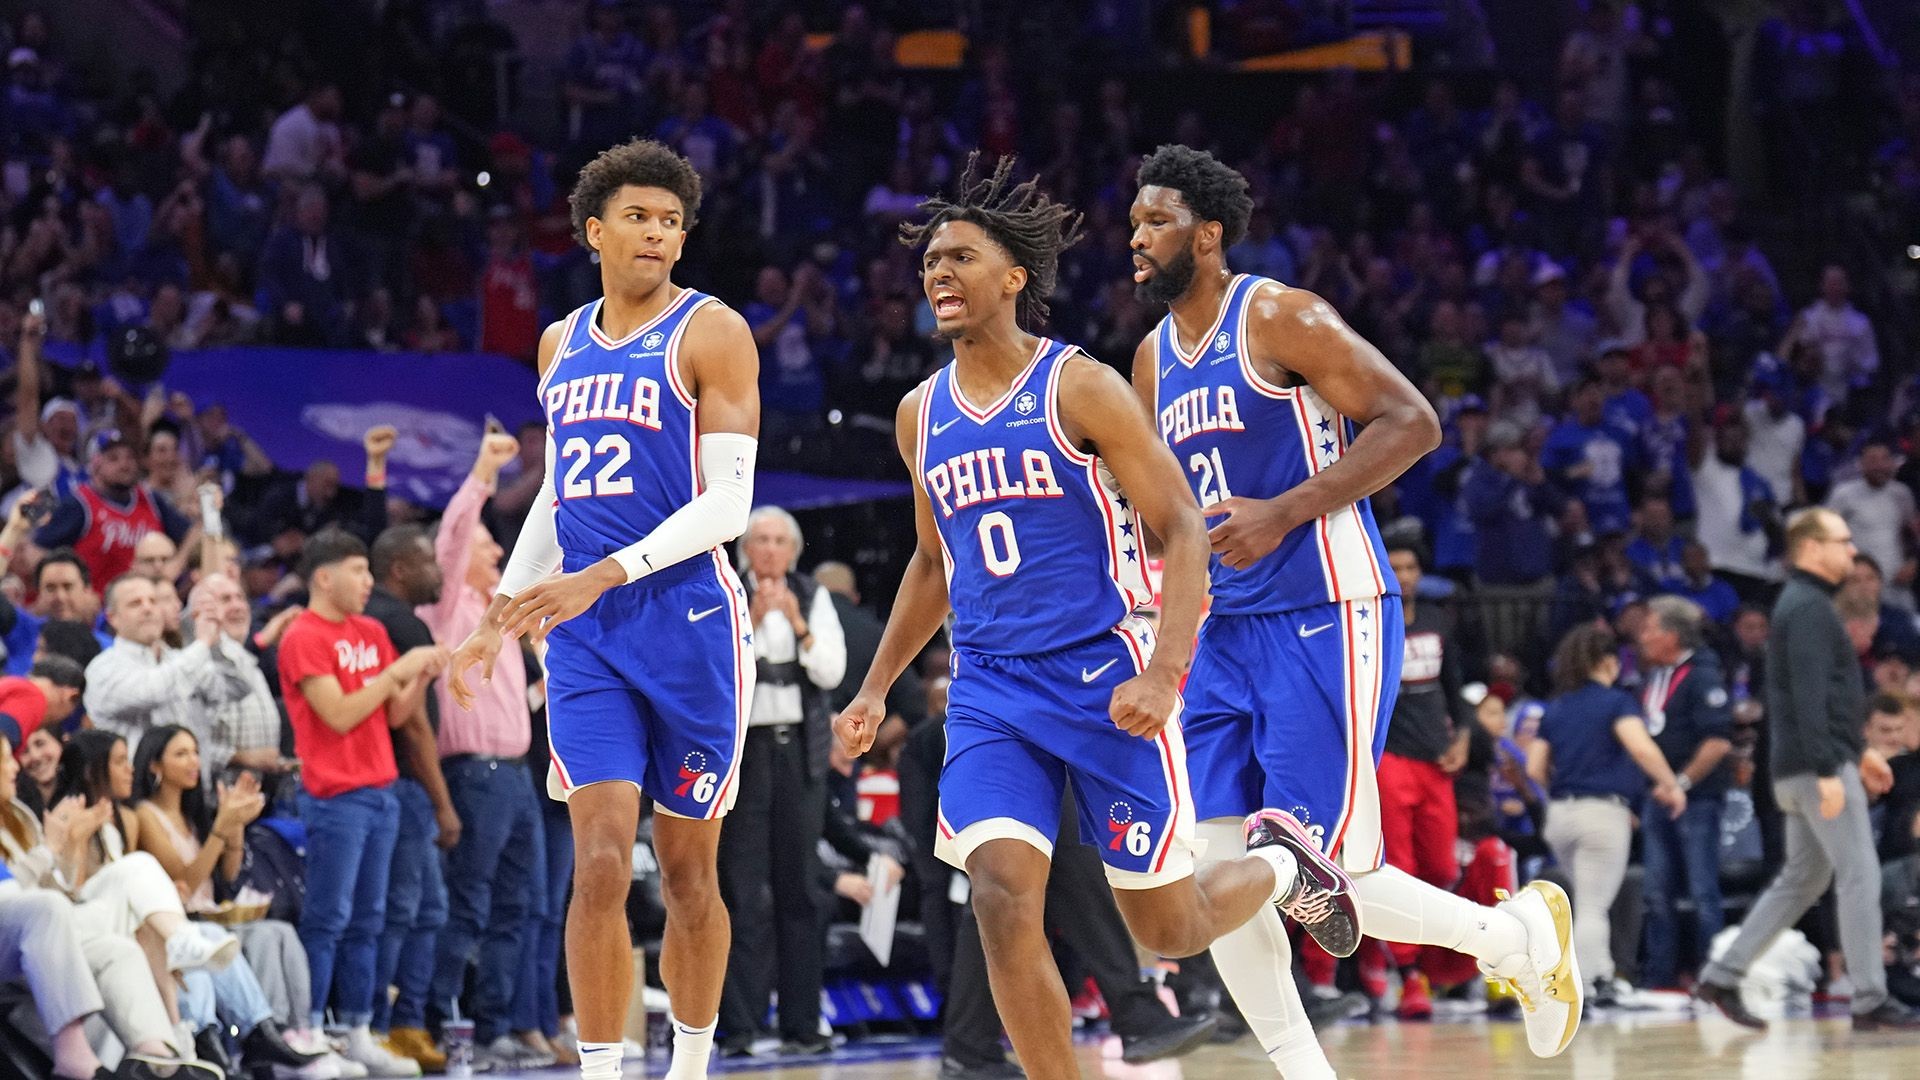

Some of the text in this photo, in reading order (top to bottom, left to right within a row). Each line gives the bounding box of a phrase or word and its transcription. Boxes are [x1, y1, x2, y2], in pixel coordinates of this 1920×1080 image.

[629, 351, 665, 359] crypto.com
[1210, 352, 1236, 366] crypto.com
[546, 373, 662, 433] PHILA
[1005, 416, 1046, 429] crypto.com
[1161, 385, 1246, 448] PHILA
[562, 434, 634, 499] 22
[926, 447, 1064, 519] PHILA
[1189, 447, 1232, 510] 21
[977, 511, 1022, 578] 0
[673, 764, 718, 804] 76
[1108, 818, 1152, 857] 76
